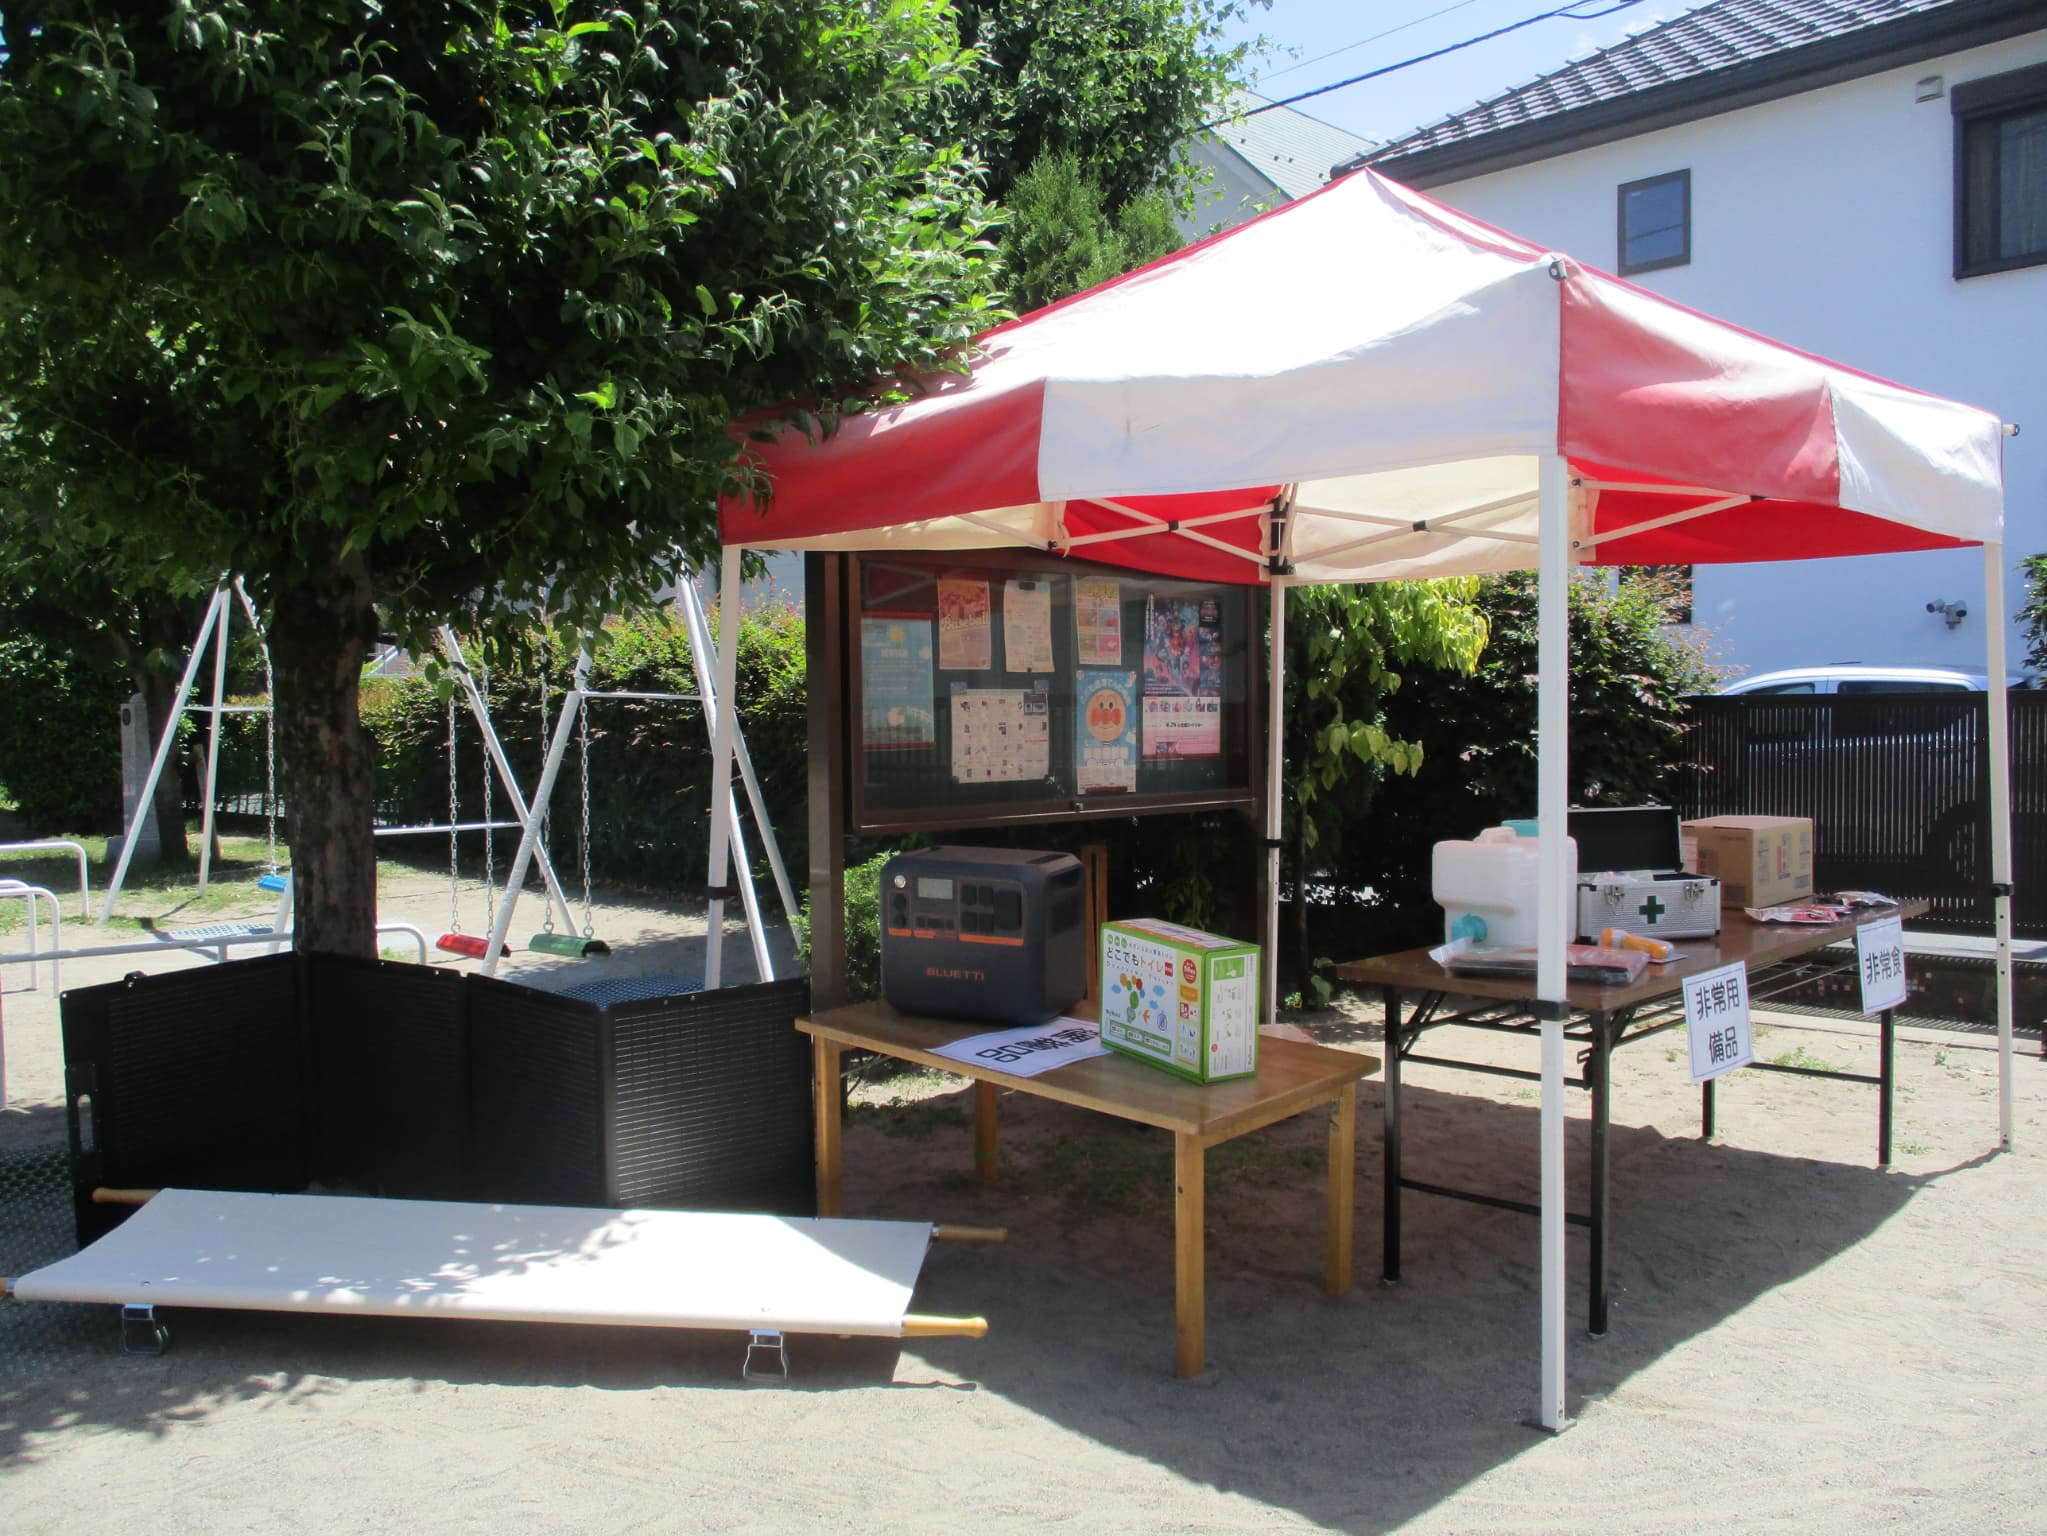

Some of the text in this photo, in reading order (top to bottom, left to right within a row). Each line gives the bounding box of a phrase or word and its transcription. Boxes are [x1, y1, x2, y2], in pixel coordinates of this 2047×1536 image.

[926, 967, 985, 981] BLUETTI
[1106, 946, 1163, 973] どこでもトイレ
[1865, 945, 1902, 985] 非常食
[1695, 977, 1740, 1021] 非常用
[1709, 1025, 1738, 1065] 備品
